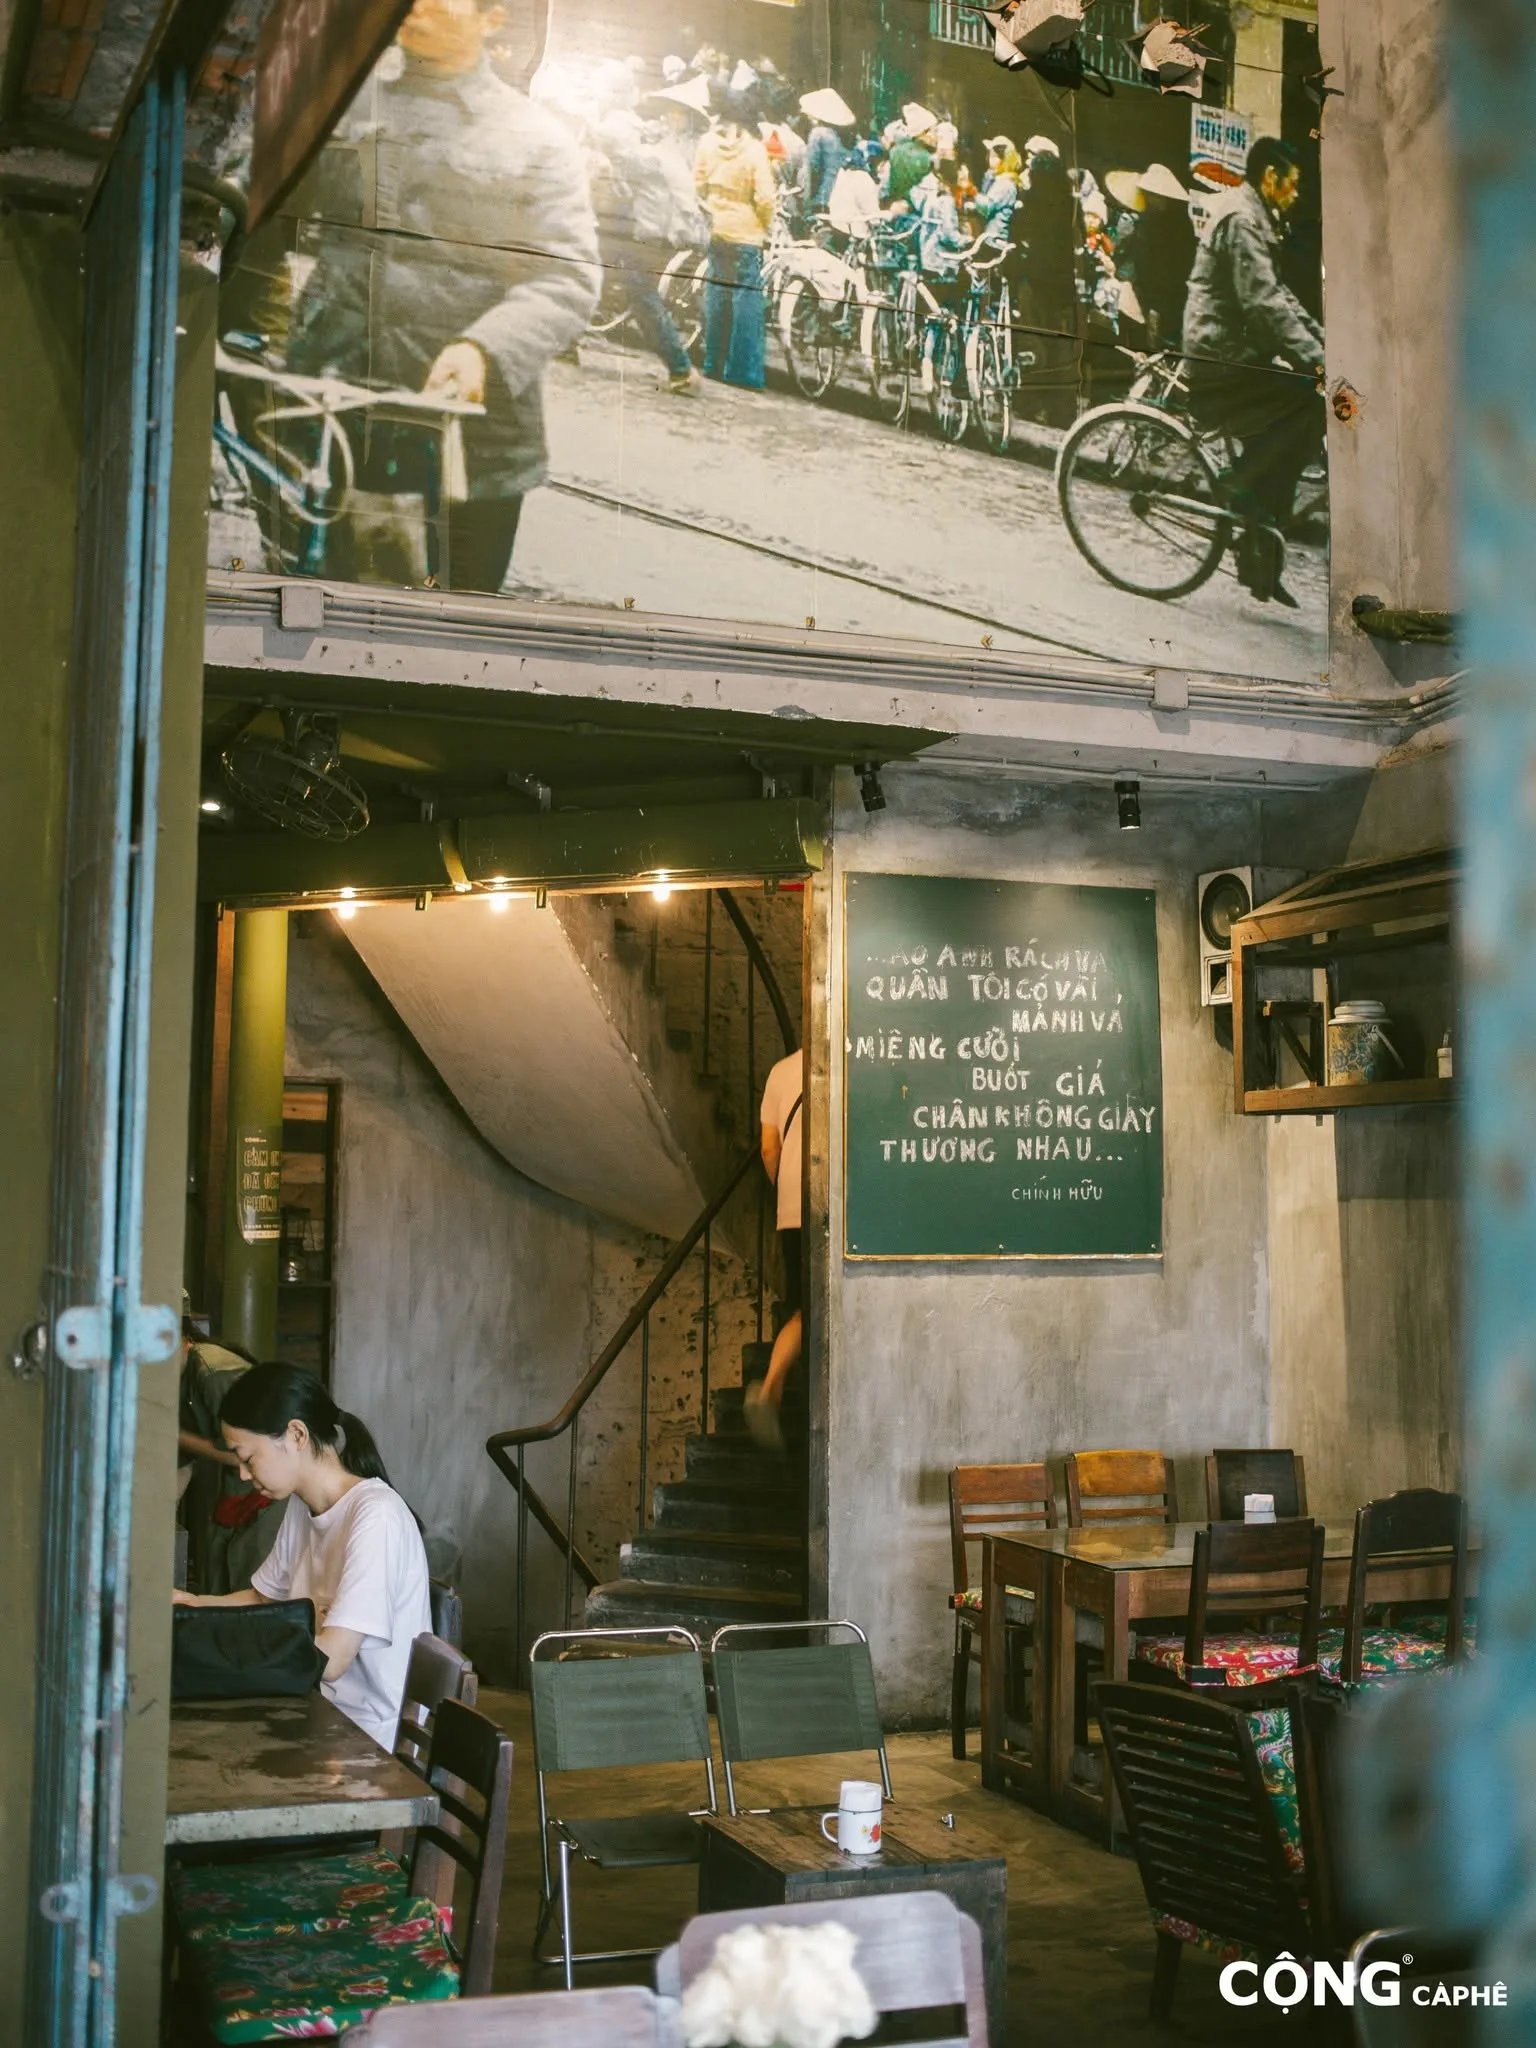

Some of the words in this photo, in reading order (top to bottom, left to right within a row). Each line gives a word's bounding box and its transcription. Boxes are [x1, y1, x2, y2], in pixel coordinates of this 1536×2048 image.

[967, 970, 1010, 1001] TÔI
[1011, 1002, 1084, 1033] MẢNH
[1055, 1058, 1106, 1097] GIÁ
[913, 1098, 988, 1129] CHÂN
[995, 1098, 1092, 1130] KHÔNG
[879, 1135, 997, 1163] THƯƠNG
[1011, 1175, 1061, 1201] CHÍNH
[1069, 1178, 1103, 1200] HỮU
